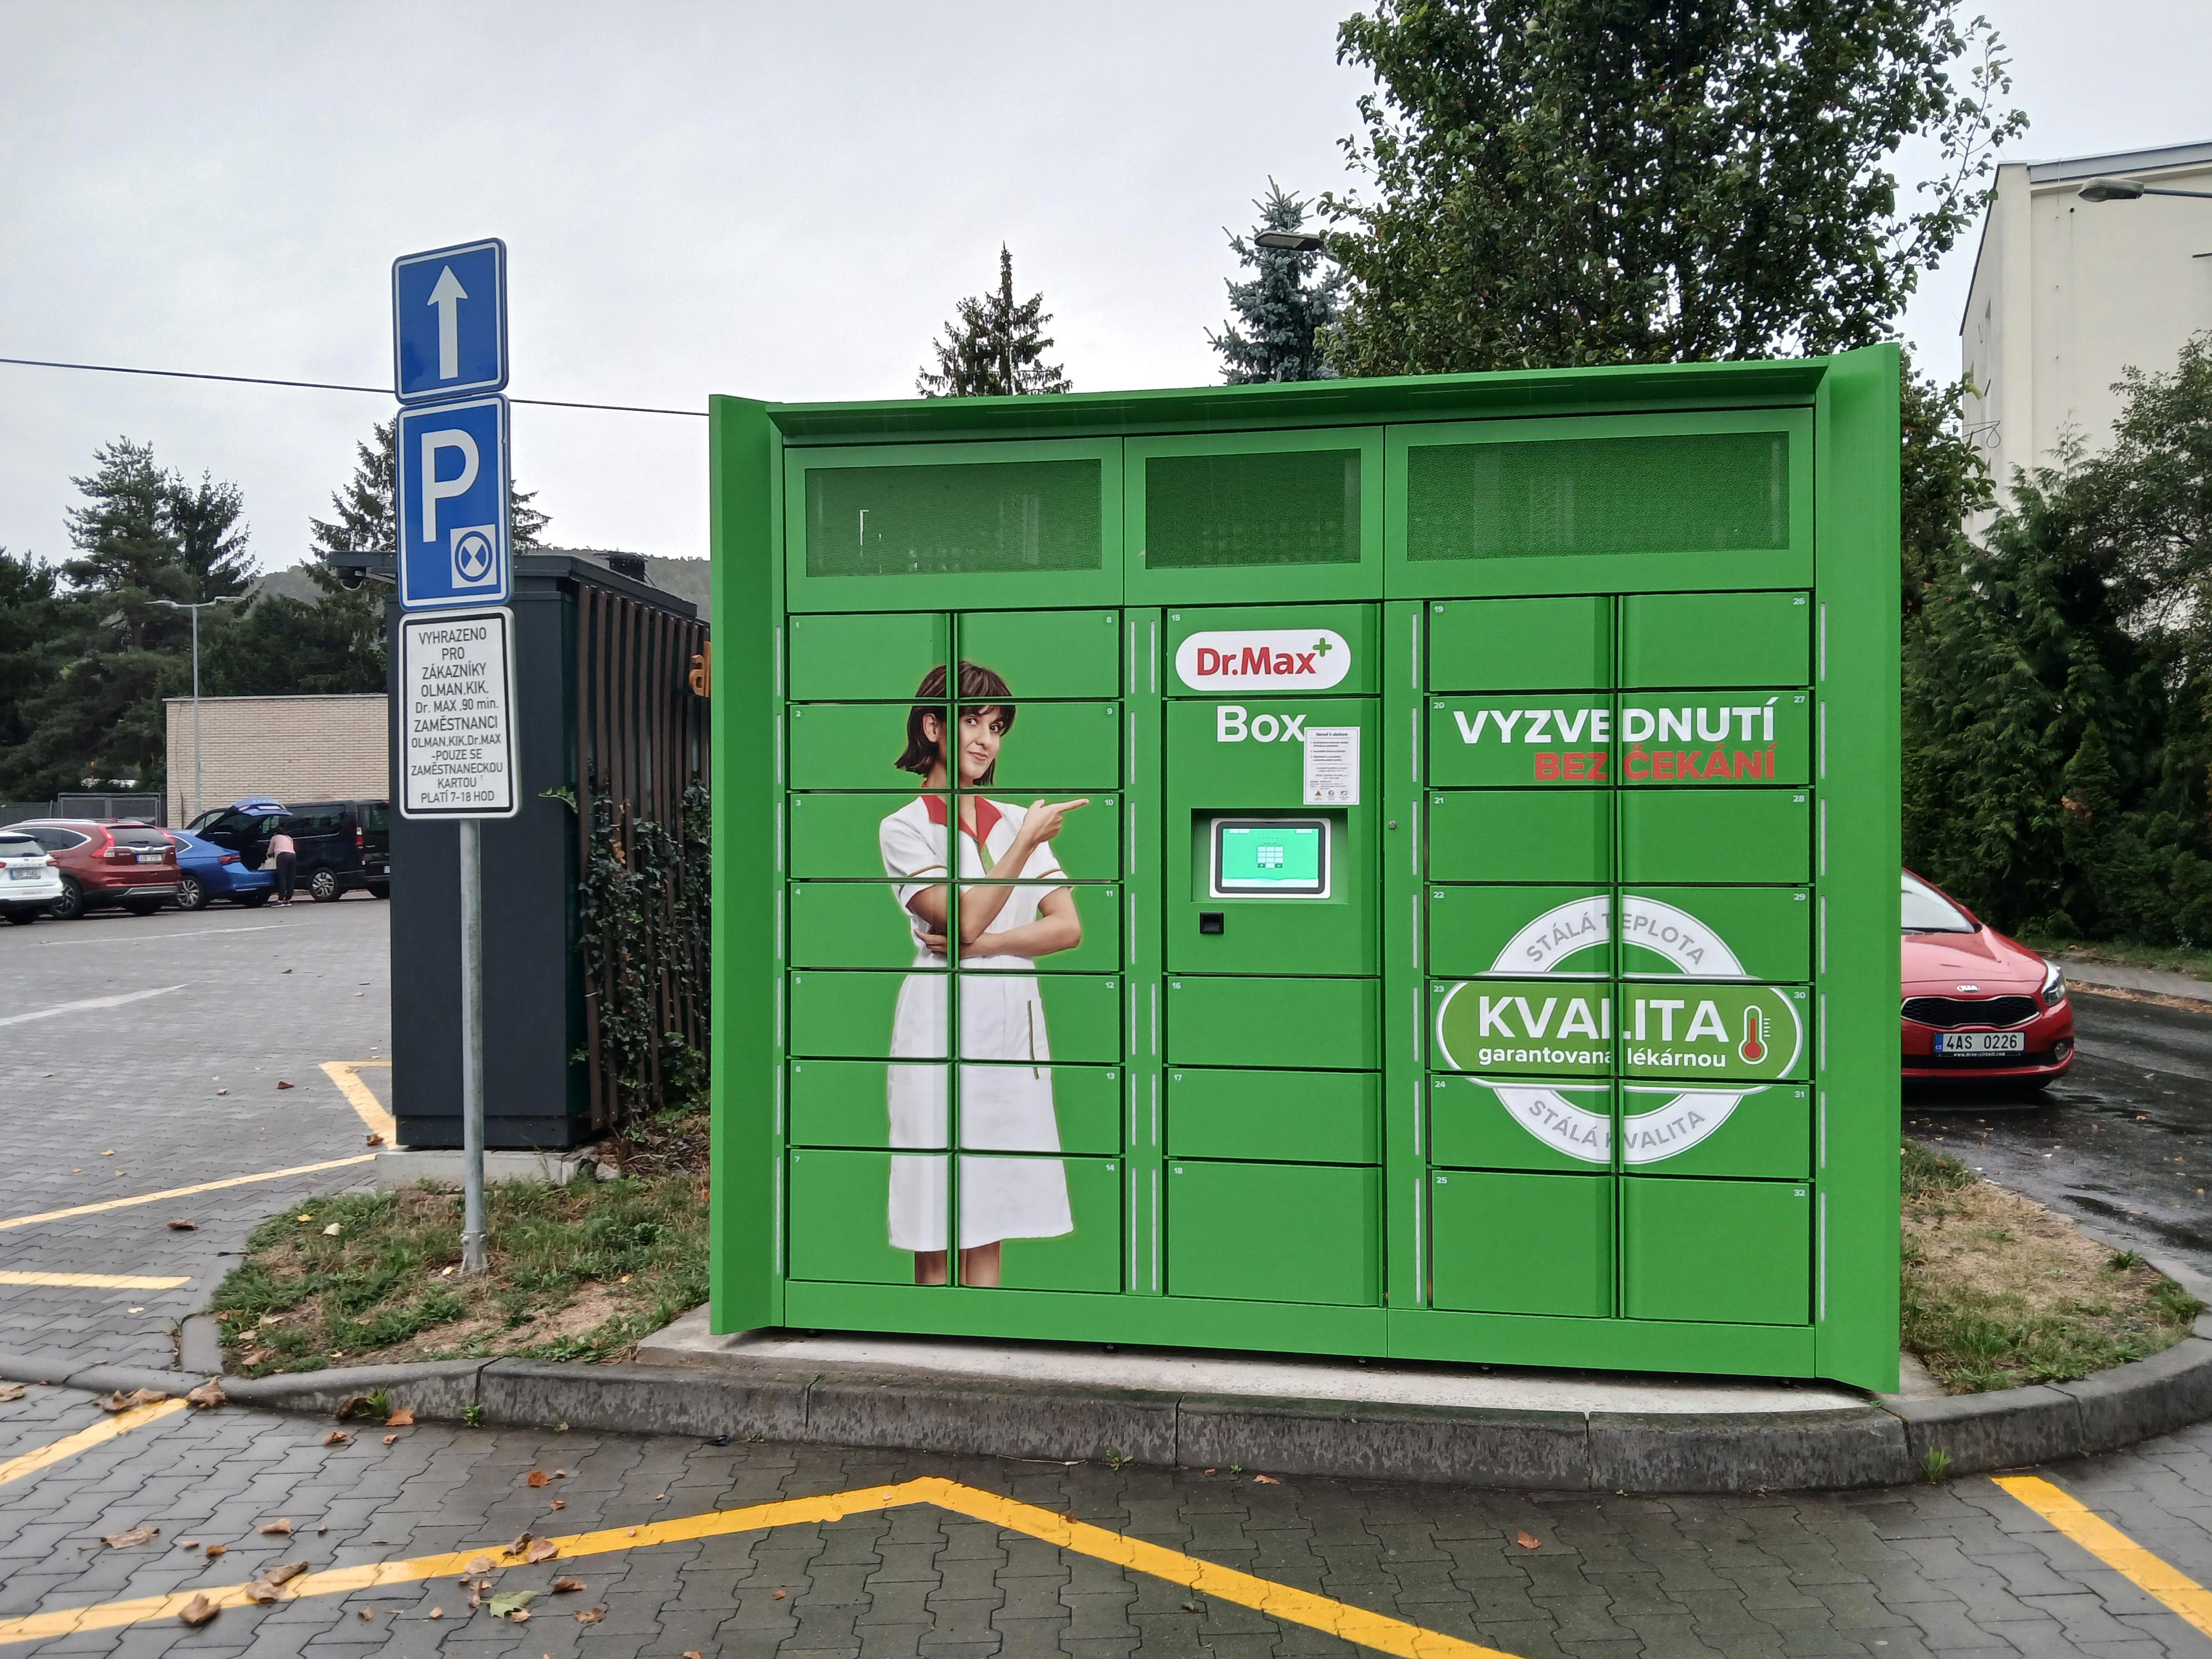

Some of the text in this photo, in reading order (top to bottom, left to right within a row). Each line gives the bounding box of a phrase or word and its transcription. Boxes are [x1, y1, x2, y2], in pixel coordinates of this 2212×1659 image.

[421, 429, 479, 542] P
[419, 627, 487, 645] VYHRAZENO
[442, 647, 465, 660] PRO
[422, 661, 487, 680] ZÁKAZNÍKY
[416, 702, 431, 713] Dr.
[434, 700, 456, 712] MAX
[477, 697, 499, 709] min.
[414, 716, 498, 732] ZAMĚSTNANCI
[1217, 705, 1307, 743] Box
[1453, 697, 1779, 744] VYZVEDNUTÍ
[469, 749, 482, 759] SE
[1535, 743, 1778, 780] BEZ ČEKÁNÍ
[411, 761, 503, 776] ZAMĚSTNANECKOU
[438, 777, 476, 789] KARTOU
[421, 790, 494, 803] PLATÍ 7-18 HOD
[1526, 912, 1704, 965] STÁLÁ TEPLOTA
[1479, 996, 1729, 1042] KVALITA
[1947, 1035, 2017, 1050] 4AS 0226
[1627, 1047, 1726, 1068] lékárnou
[1529, 1100, 1597, 1146] STÁLÁ
